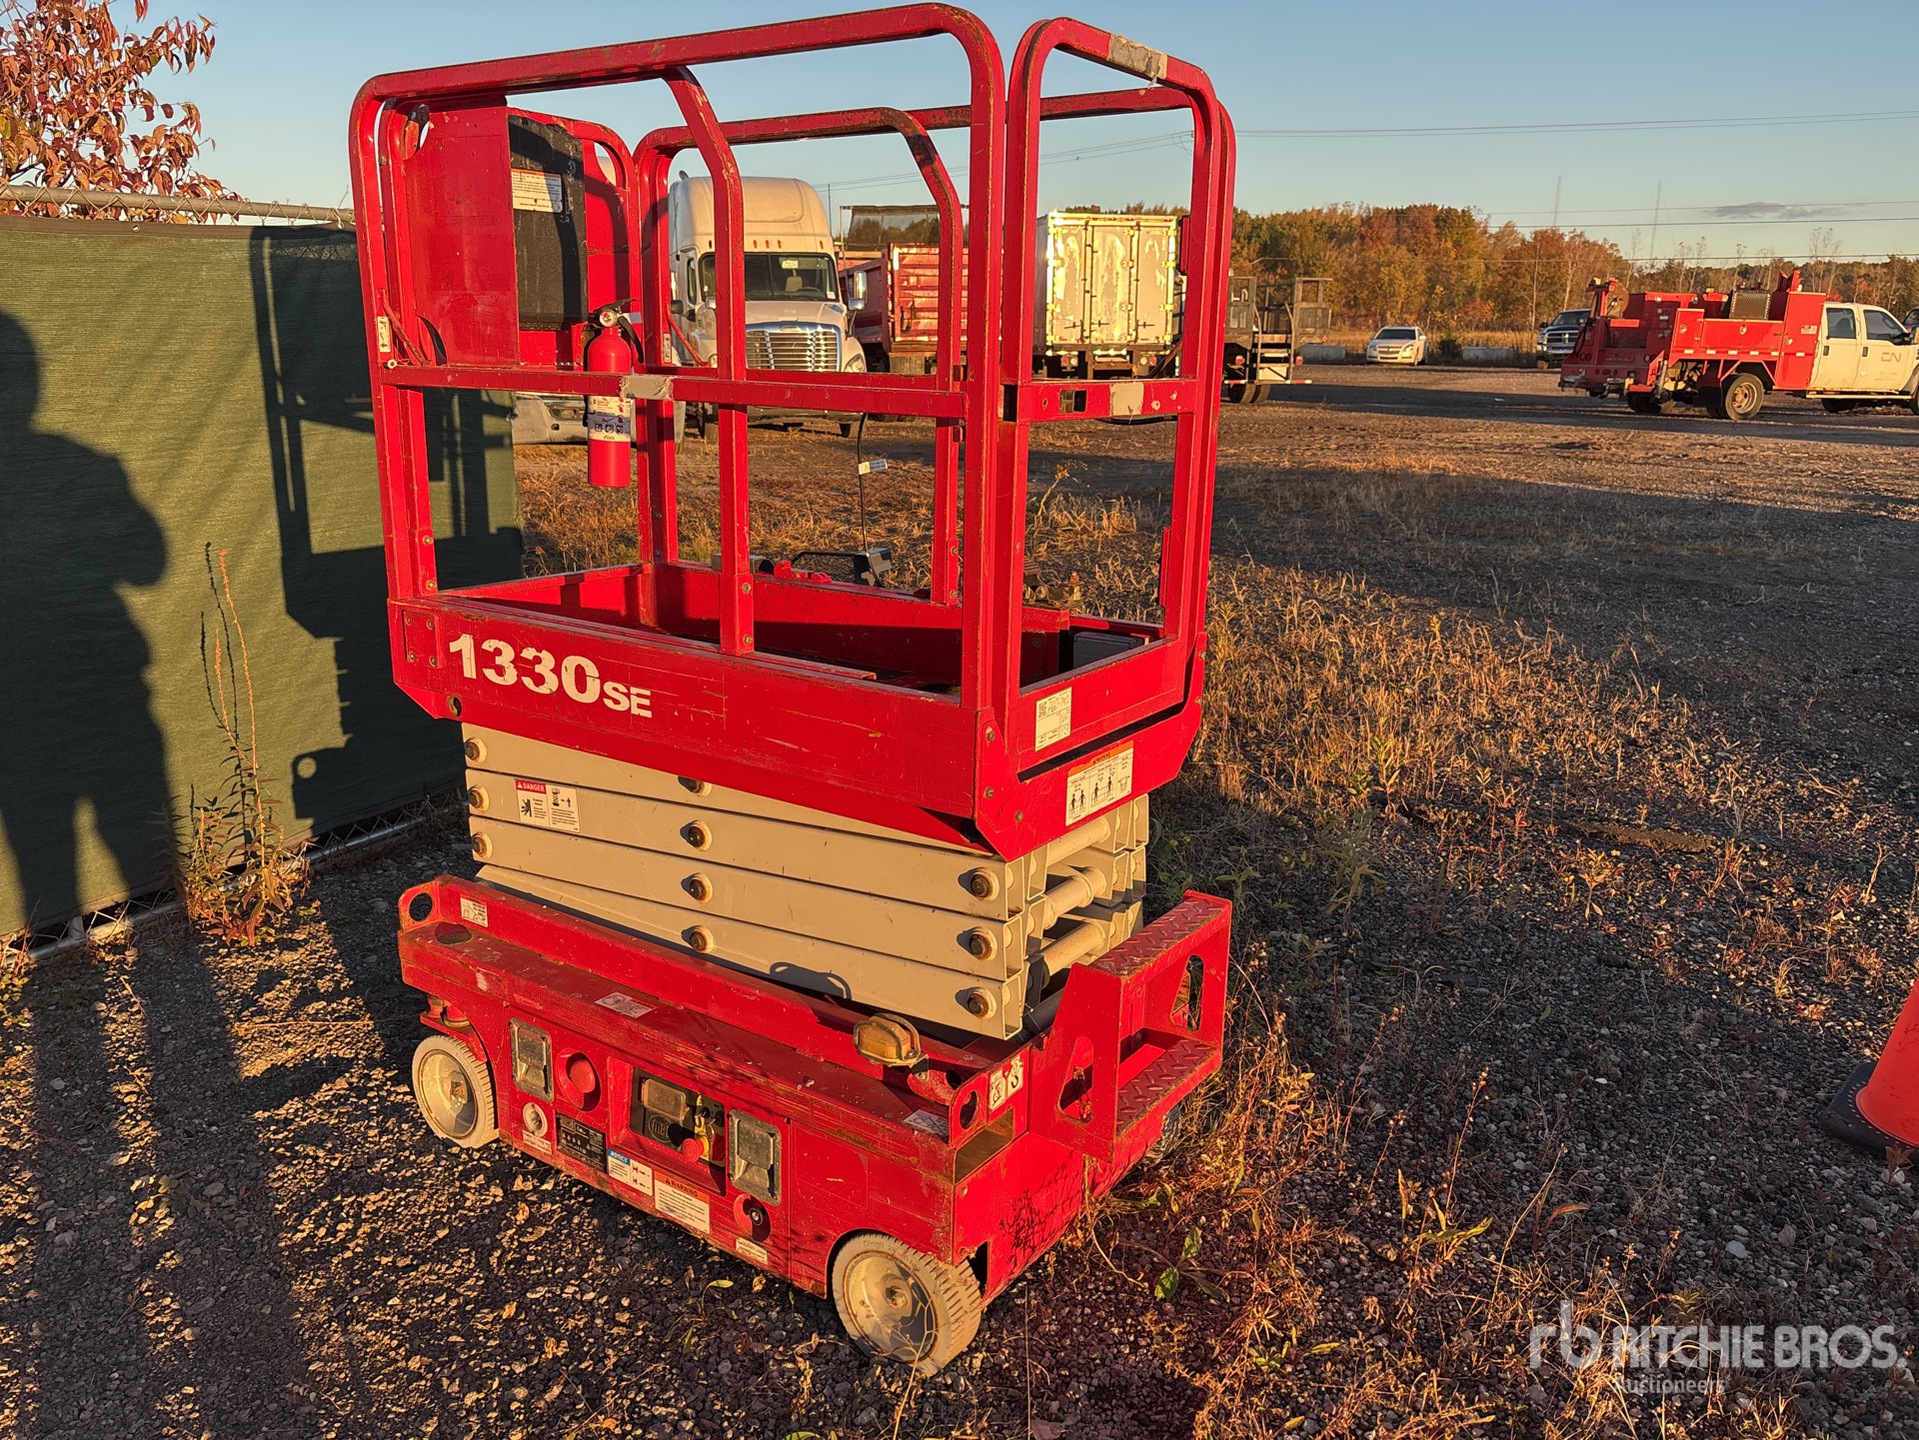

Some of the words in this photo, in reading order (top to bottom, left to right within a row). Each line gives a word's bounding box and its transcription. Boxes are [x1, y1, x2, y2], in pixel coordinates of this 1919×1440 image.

[1881, 352, 1902, 362] CN
[522, 782, 546, 792] DANGER
[610, 1149, 629, 1164] NOTICE
[671, 1180, 699, 1198] WARNING
